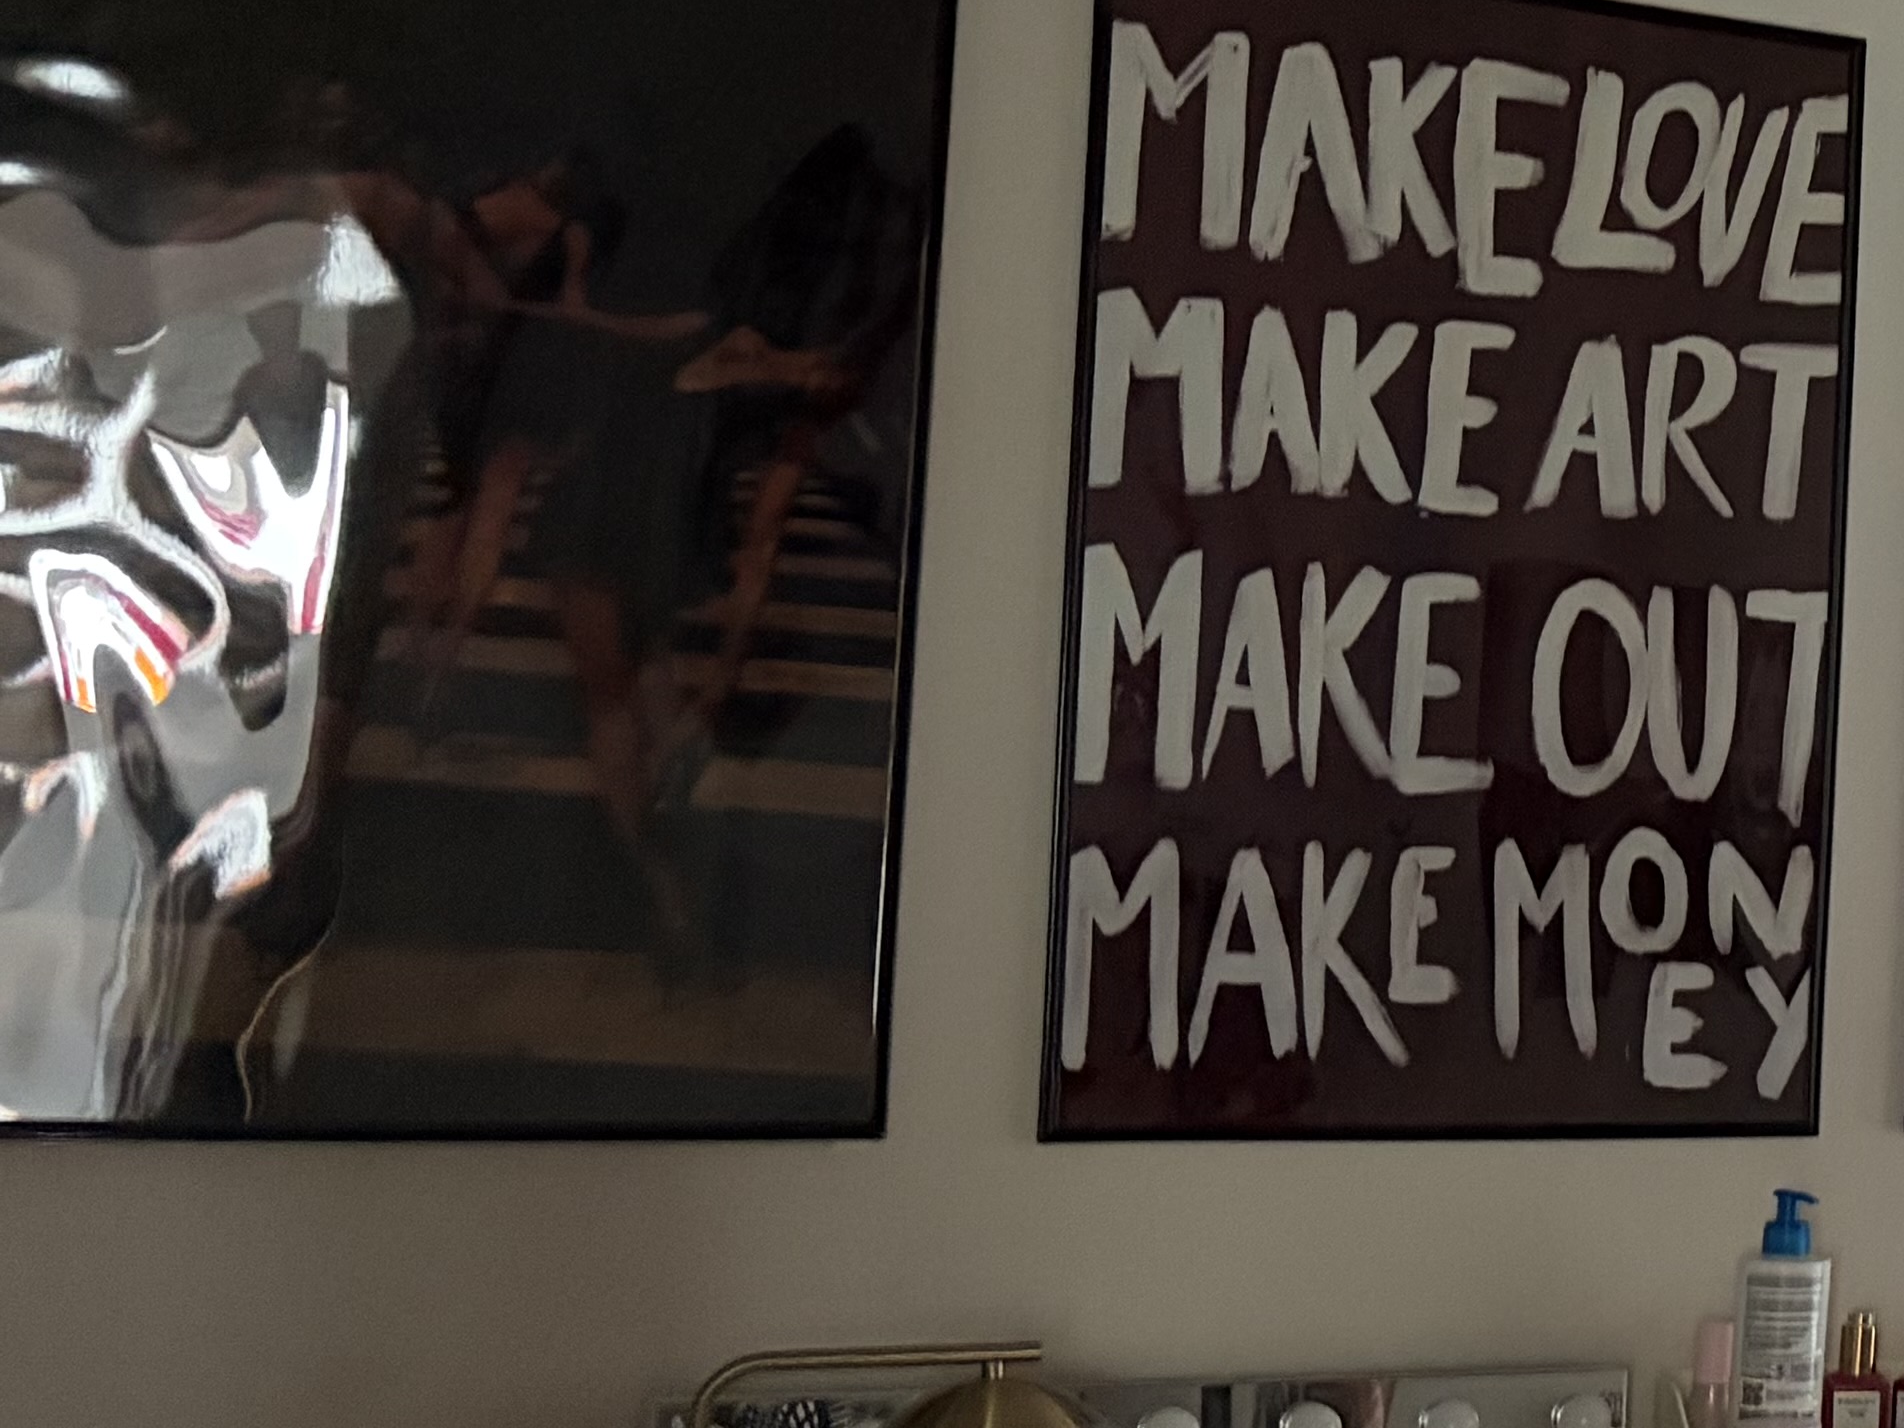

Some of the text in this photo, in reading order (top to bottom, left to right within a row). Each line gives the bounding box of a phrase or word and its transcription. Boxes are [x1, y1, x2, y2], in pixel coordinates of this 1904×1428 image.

[1101, 18, 1849, 304] MAKE LOVE
[1086, 286, 1838, 520] MAKE ART
[1073, 542, 1829, 828] MAKE OUT
[1061, 836, 1458, 1071] MAKE
